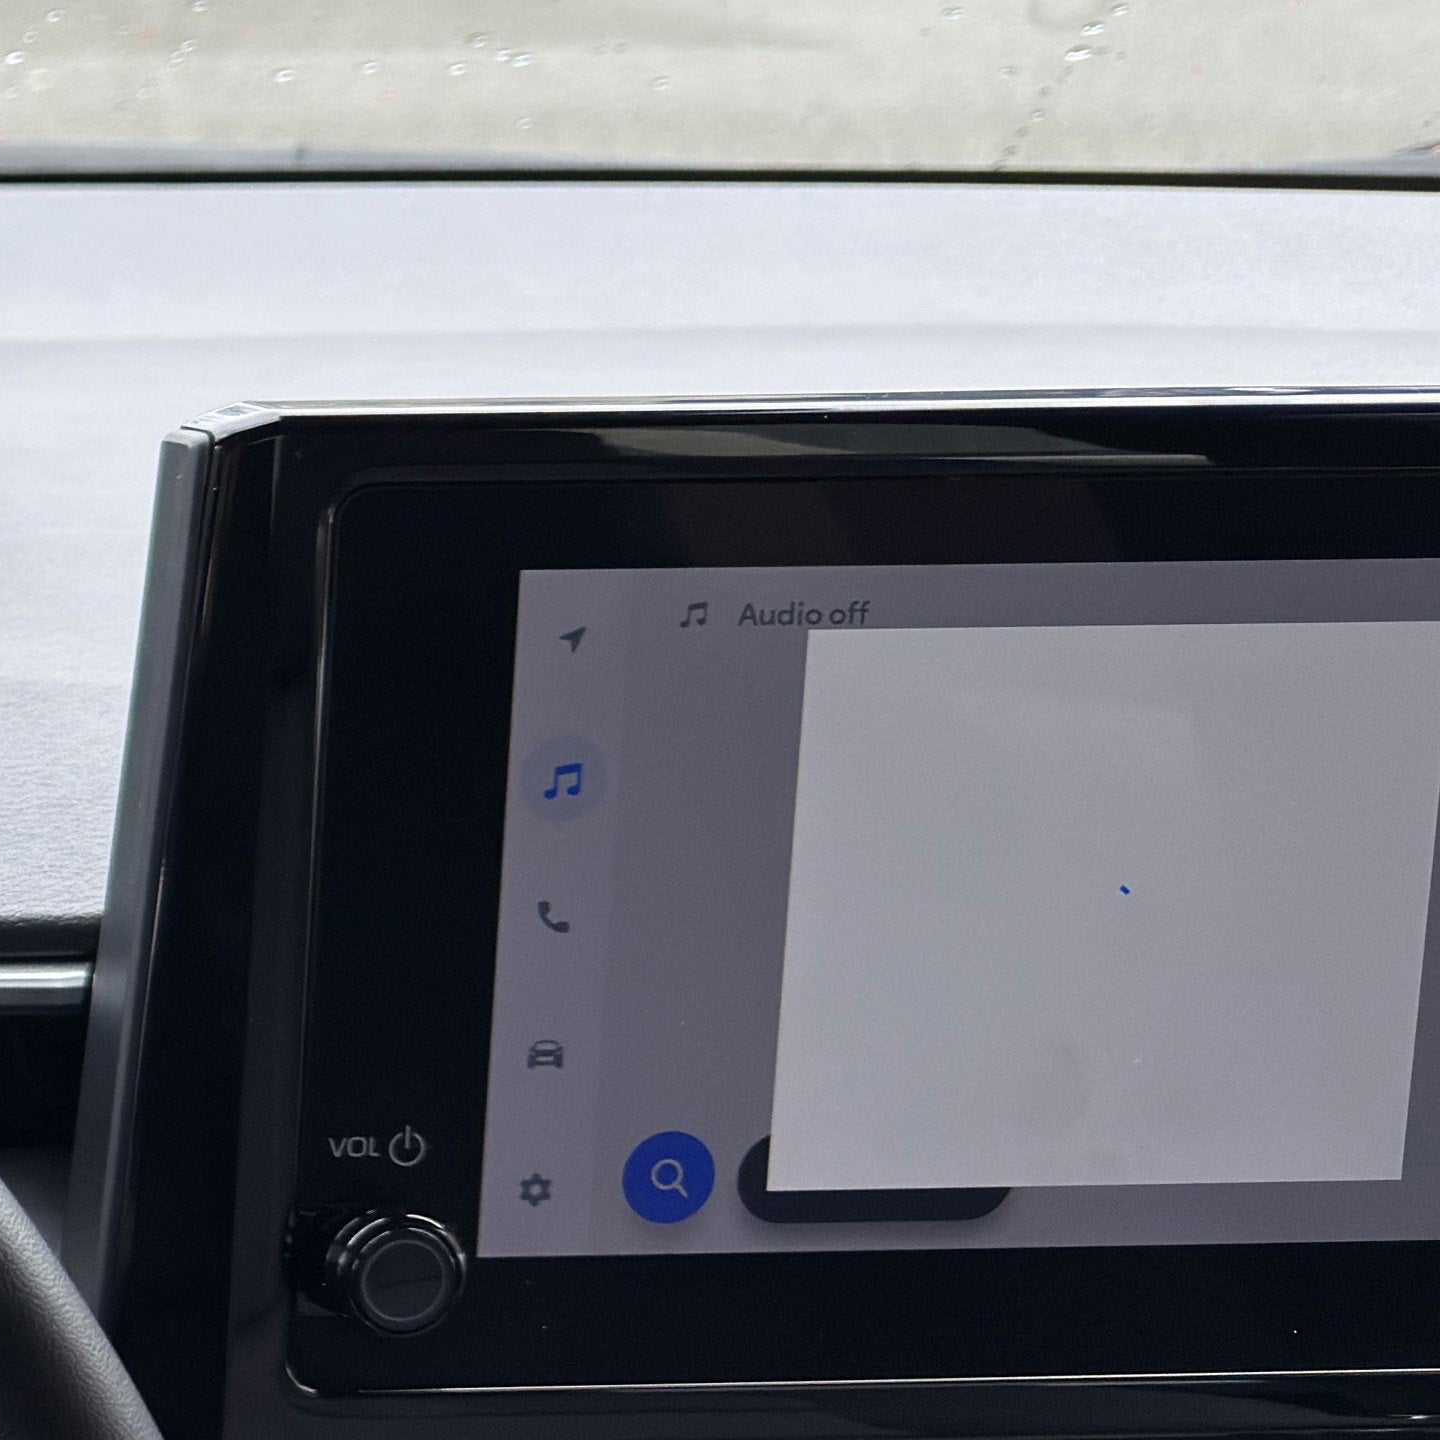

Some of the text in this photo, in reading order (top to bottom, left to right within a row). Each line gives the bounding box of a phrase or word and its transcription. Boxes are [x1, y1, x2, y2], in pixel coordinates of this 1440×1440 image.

[738, 601, 870, 627] Audio off
[329, 1136, 379, 1158] VOL
